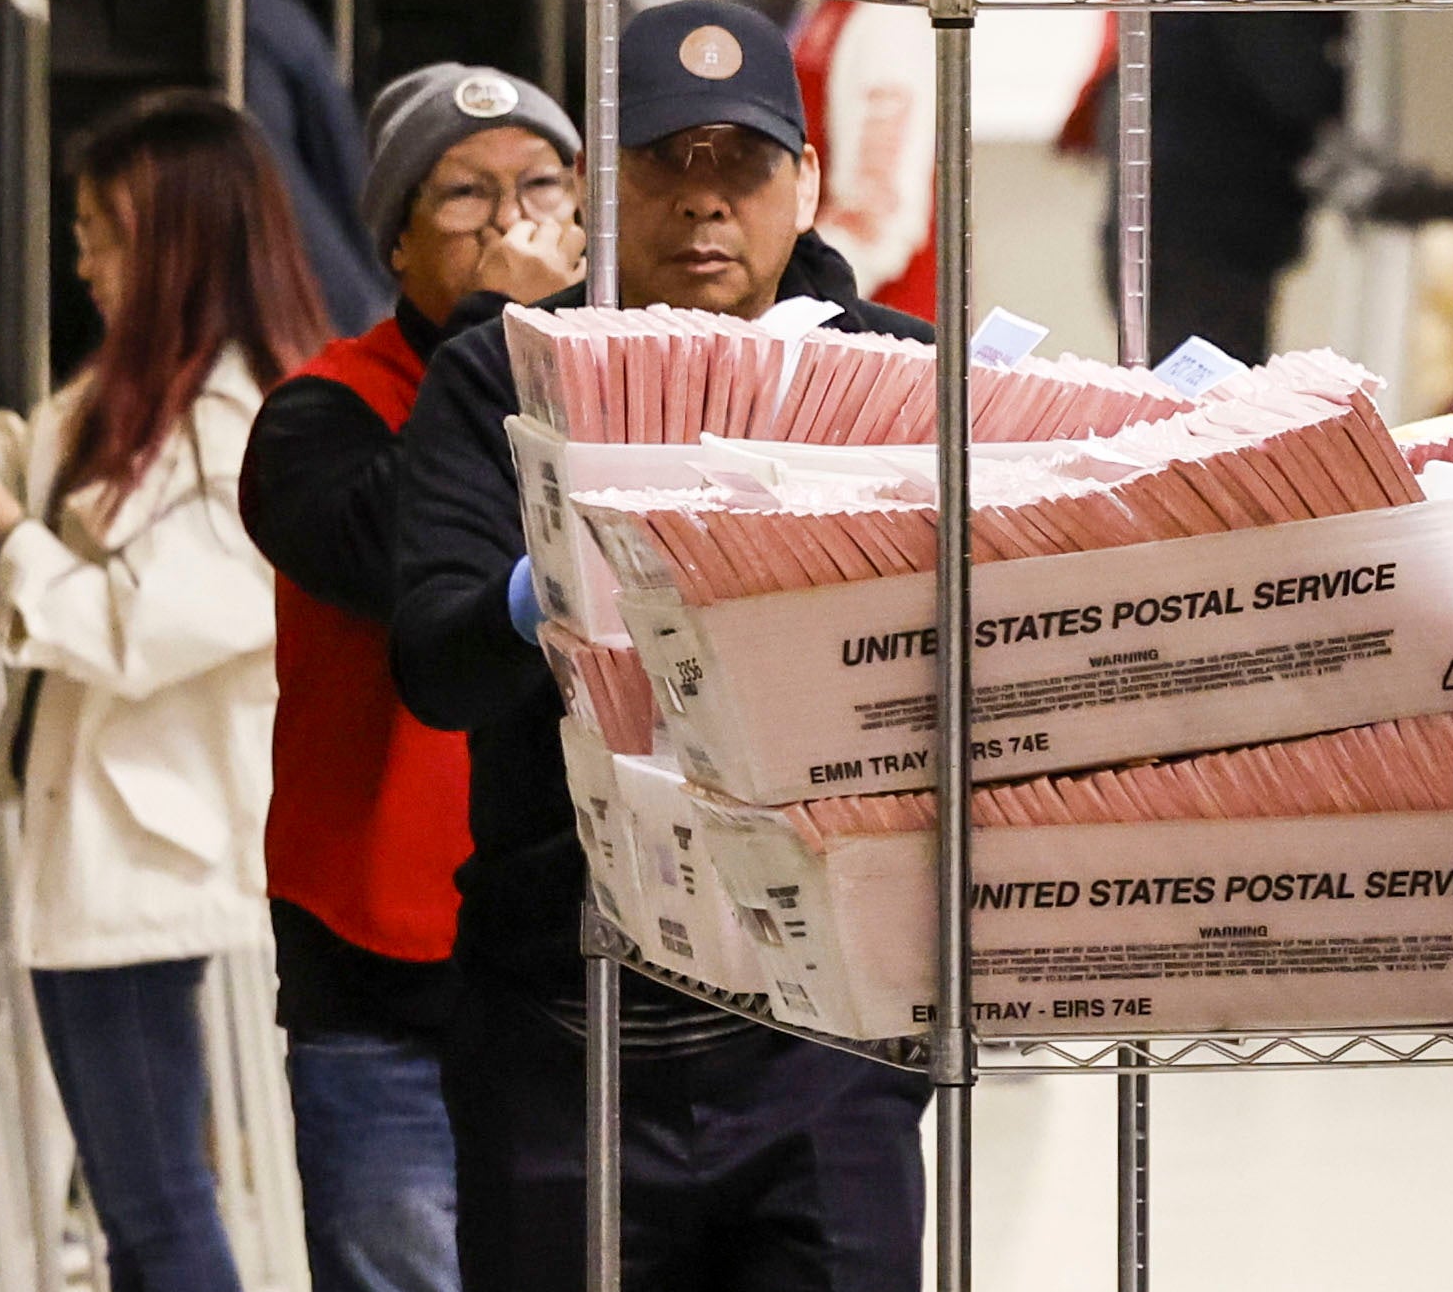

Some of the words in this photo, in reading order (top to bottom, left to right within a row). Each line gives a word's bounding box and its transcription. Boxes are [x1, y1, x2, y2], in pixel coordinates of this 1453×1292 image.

[843, 627, 938, 667] UNITE
[975, 606, 1103, 648] STATES
[1112, 588, 1244, 631] POSTAL
[1252, 563, 1397, 610] SERVICE
[1089, 648, 1159, 669] WARNING
[810, 763, 863, 784] EMM
[869, 750, 930, 776] TRAY
[1008, 733, 1050, 753] 74E
[1089, 876, 1216, 908] STATES
[1225, 872, 1355, 903] POSTAL
[1199, 924, 1268, 940] WARNING
[972, 1001, 1032, 1022] TRAY
[1053, 999, 1105, 1018] EIRS
[1112, 997, 1152, 1017] 74E
